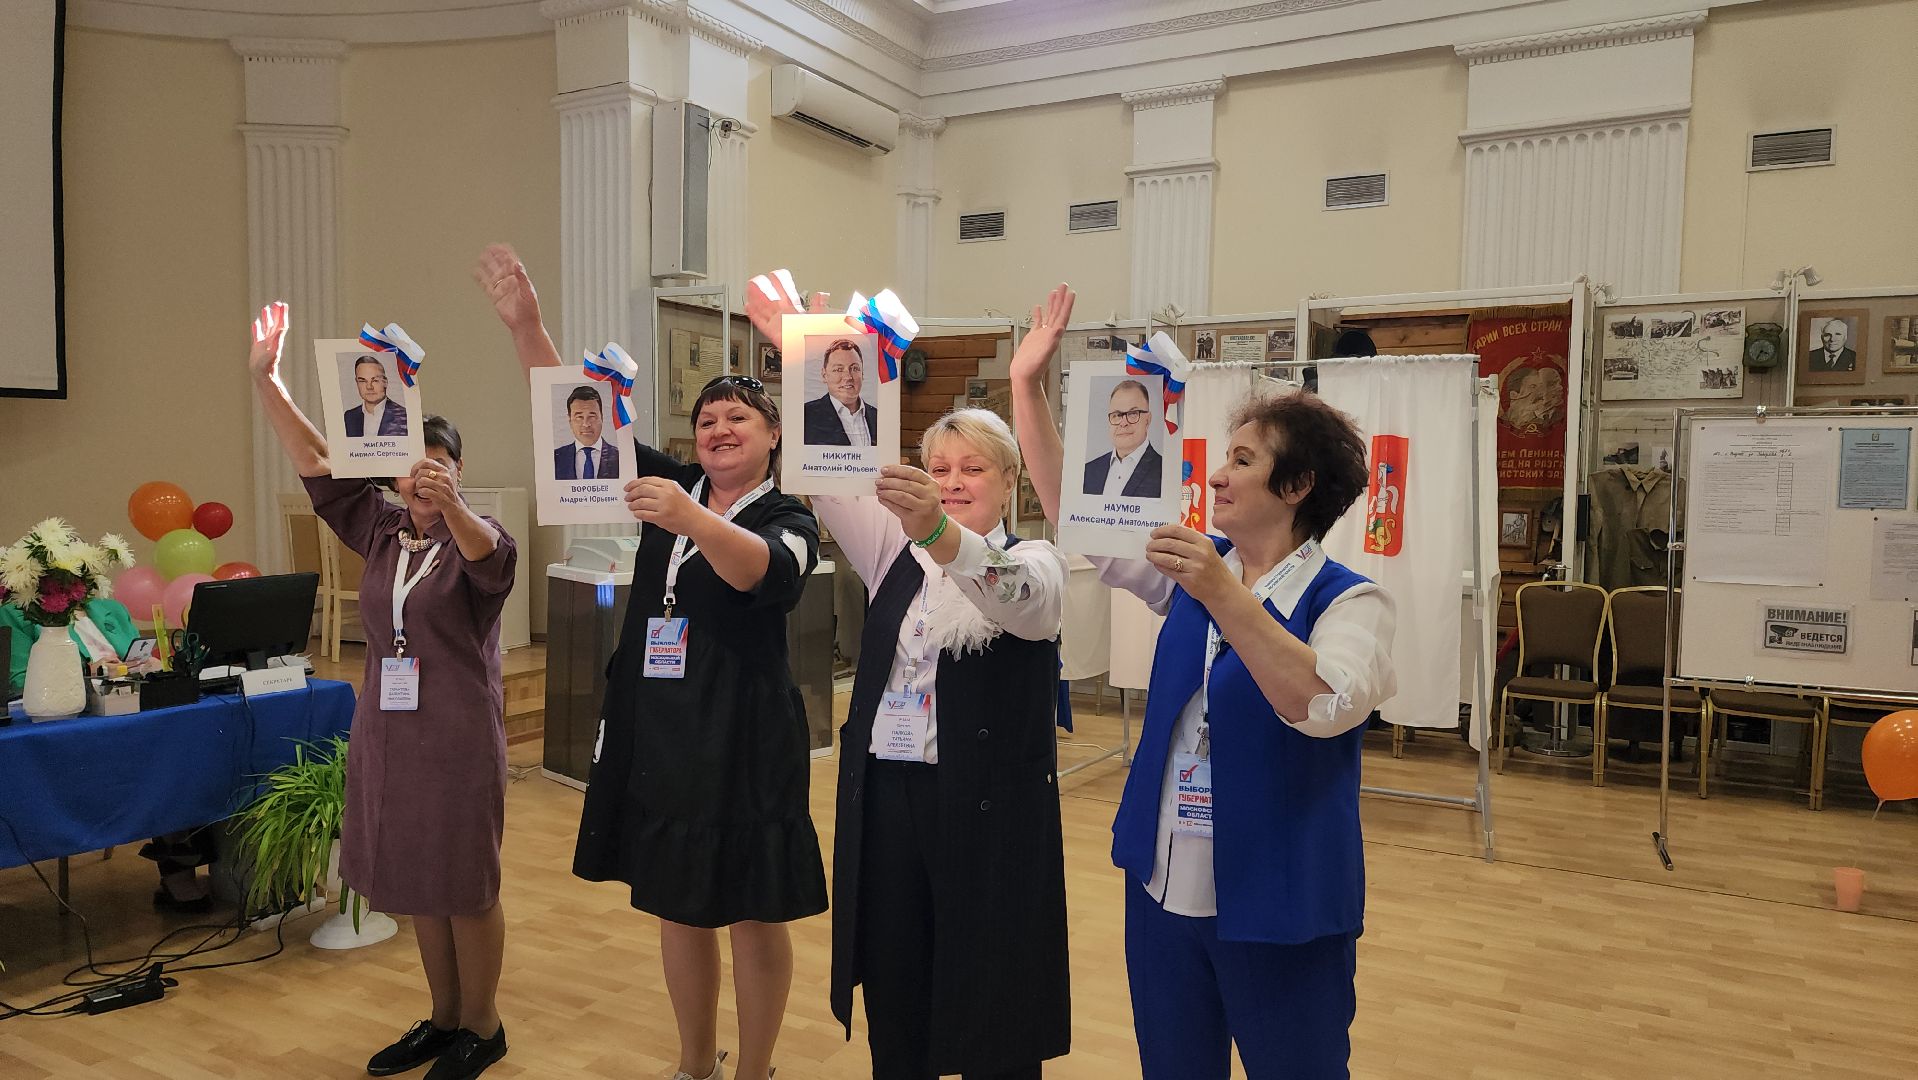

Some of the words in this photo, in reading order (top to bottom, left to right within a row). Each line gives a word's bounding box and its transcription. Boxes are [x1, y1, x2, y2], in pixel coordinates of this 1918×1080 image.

[1502, 322, 1528, 337] ВСЕХ
[822, 452, 862, 460] НИКИТИН
[802, 463, 842, 472] Анатолий
[1518, 459, 1531, 468] НА
[1104, 503, 1141, 514] НАУМОВ
[1069, 513, 1116, 527] Александр
[1767, 608, 1847, 624] ВНИМАНИЕ!
[1800, 632, 1843, 643] ВЕДЕТСЯ
